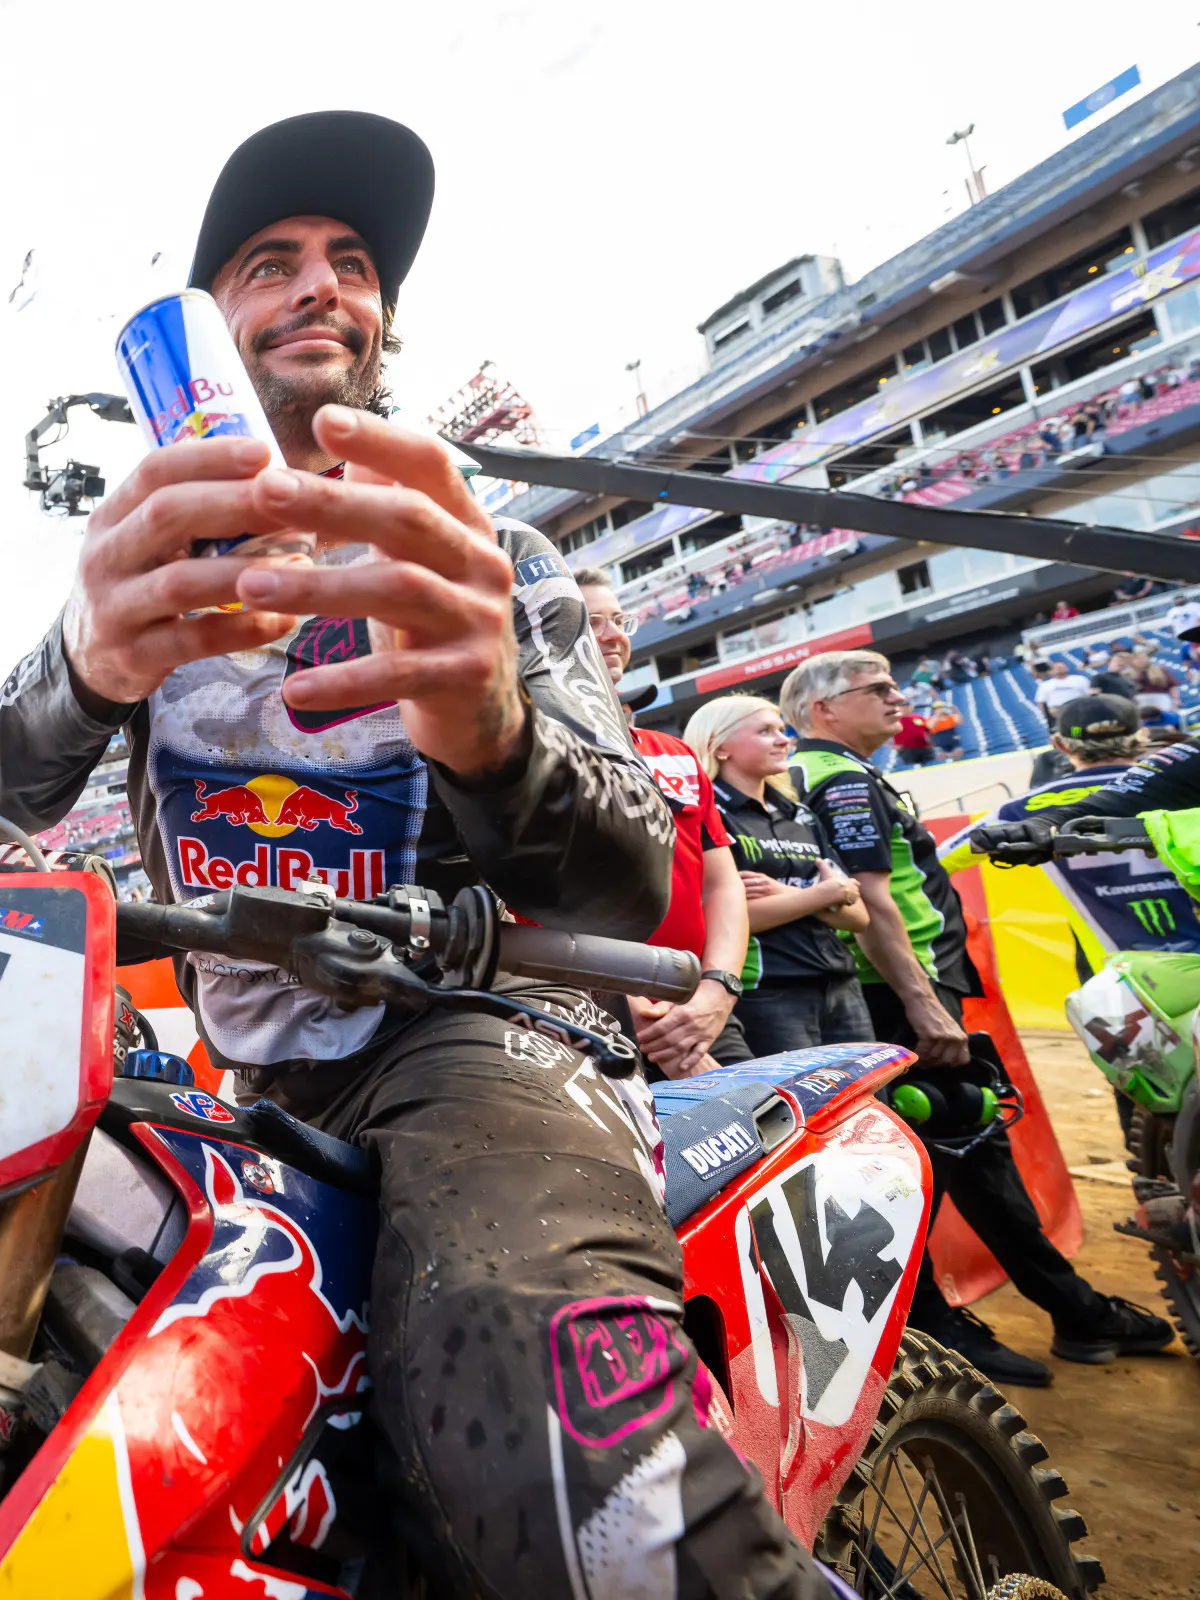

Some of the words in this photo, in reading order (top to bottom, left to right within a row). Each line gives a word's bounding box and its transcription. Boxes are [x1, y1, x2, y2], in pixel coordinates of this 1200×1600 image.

[744, 648, 810, 676] NISSAN
[177, 836, 272, 890] Red
[276, 847, 386, 900] Bull
[199, 958, 280, 983] FACTORY
[683, 1121, 754, 1174] DUCATI
[748, 1163, 904, 1412] 14
